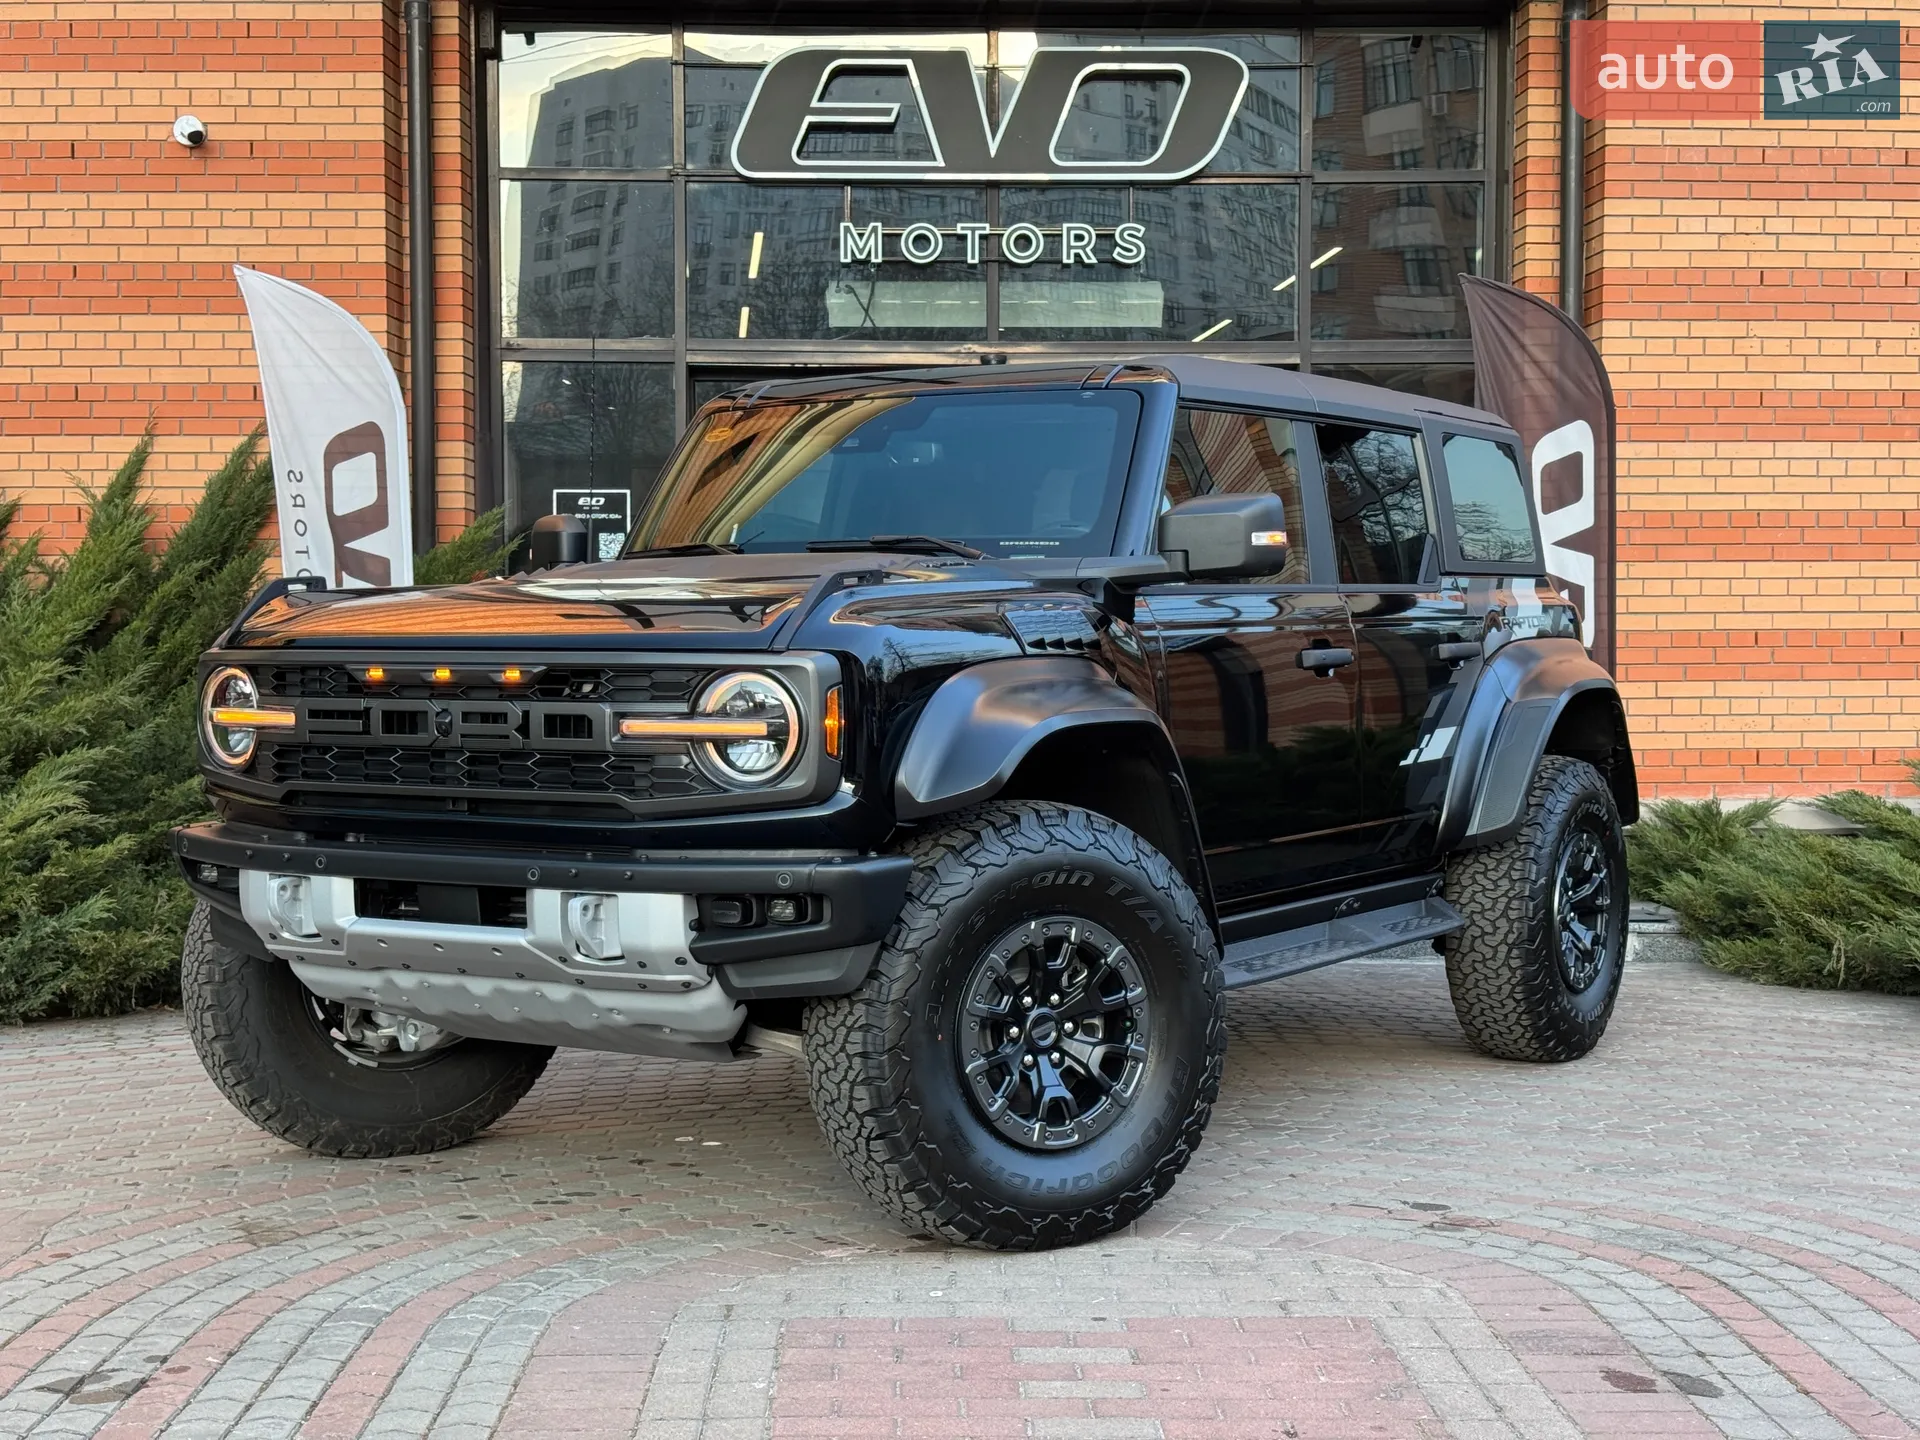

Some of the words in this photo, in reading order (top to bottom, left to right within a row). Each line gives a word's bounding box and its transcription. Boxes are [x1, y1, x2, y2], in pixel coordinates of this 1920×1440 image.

[730, 45, 1249, 181] EVO
[840, 222, 1146, 265] MOTORS
[1105, 876, 1166, 933] T/A
[979, 1056, 1190, 1198] BFGoodrich
